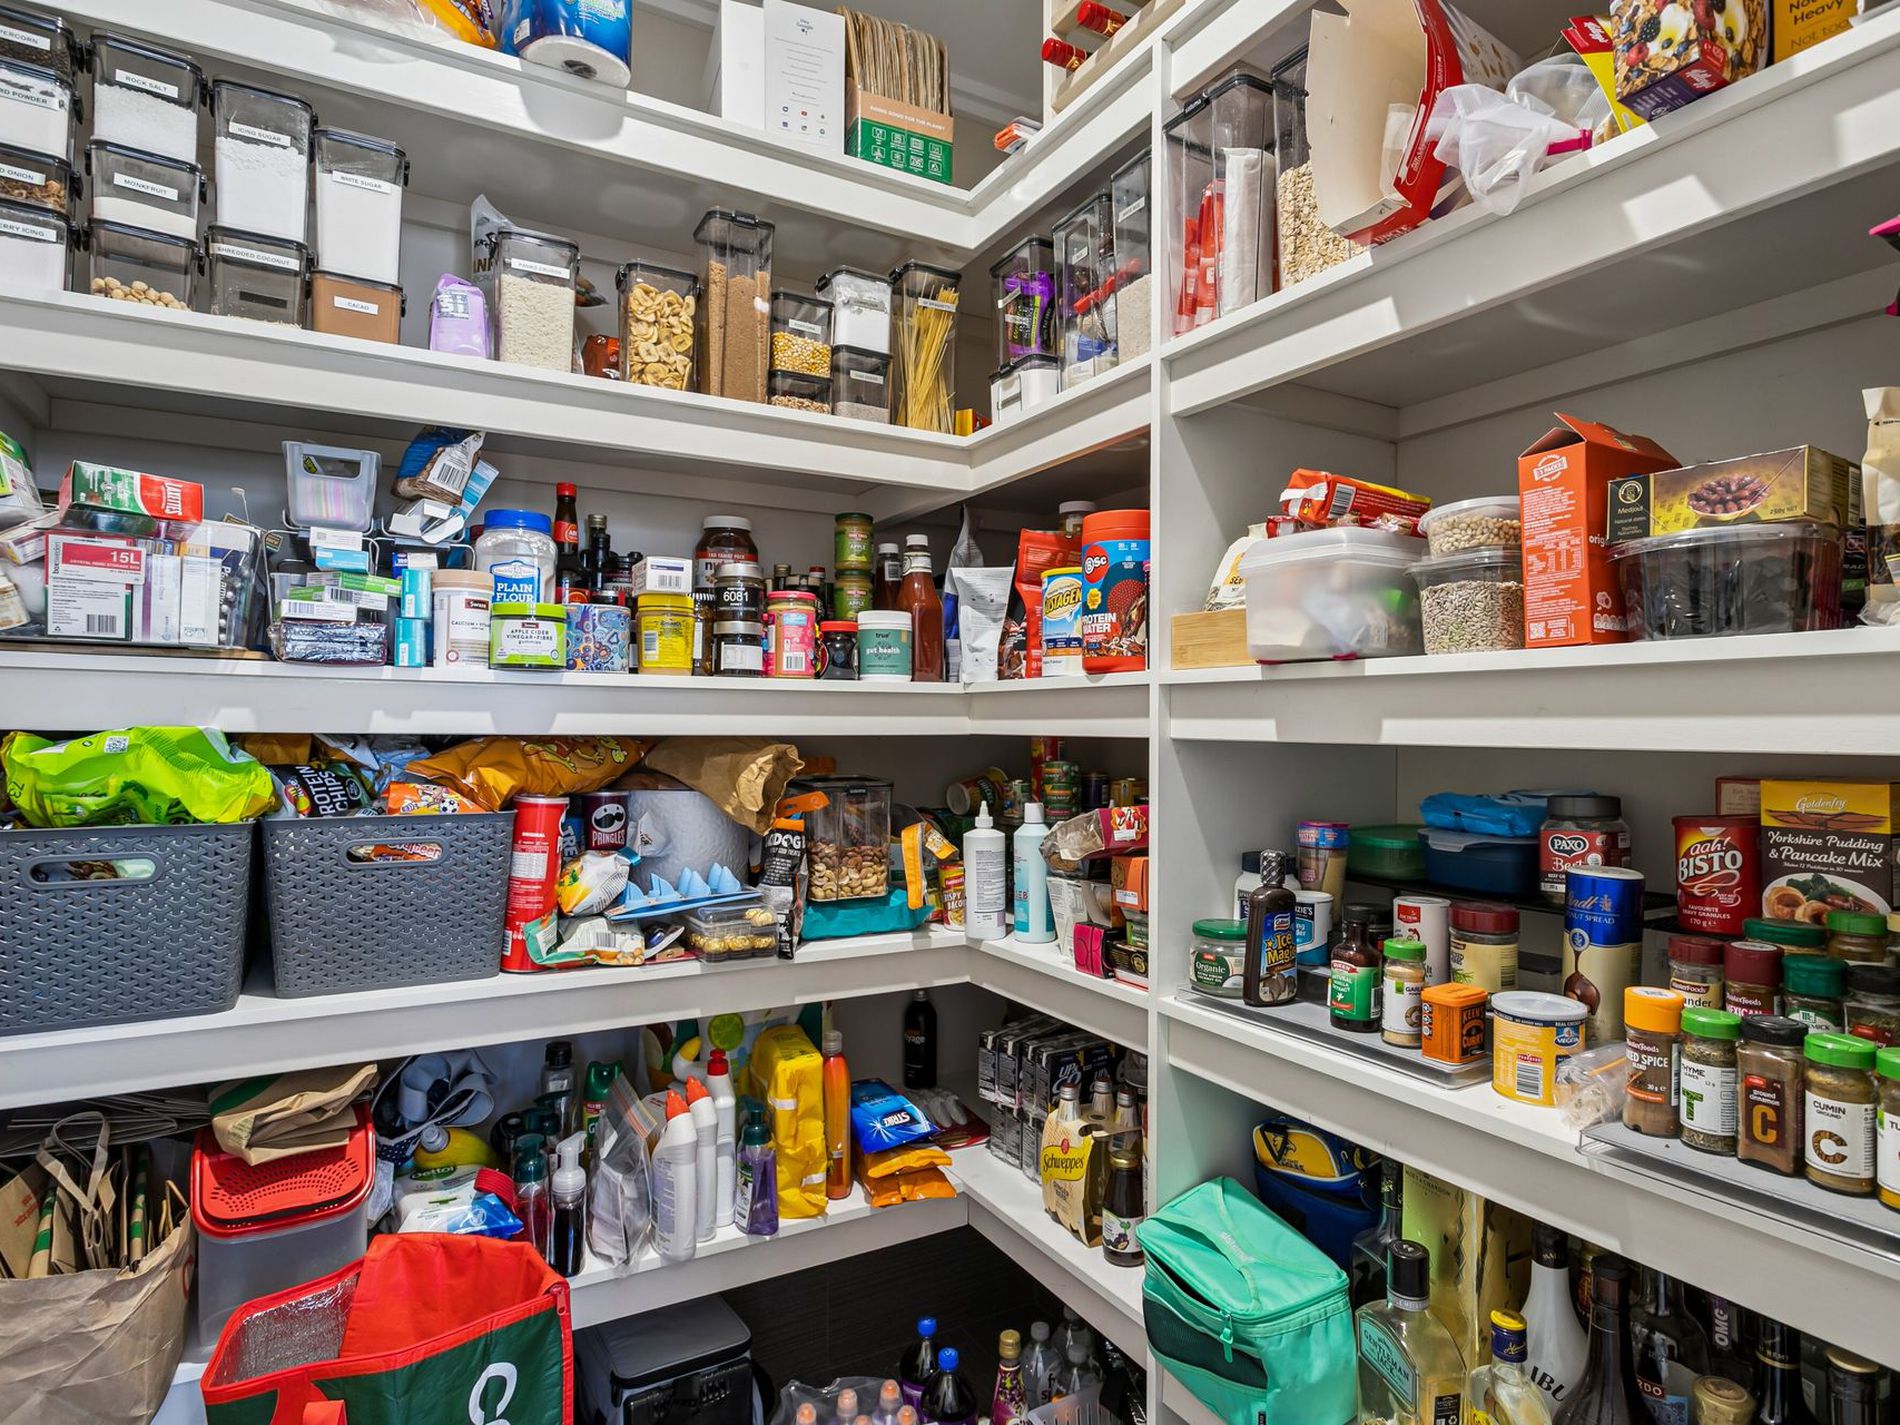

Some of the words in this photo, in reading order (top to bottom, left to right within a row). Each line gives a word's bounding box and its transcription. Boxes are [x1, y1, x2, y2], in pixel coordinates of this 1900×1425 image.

[1793, 0, 1844, 26] Heavy
[0, 29, 38, 44] ERCORN
[125, 74, 147, 87] ROCK
[149, 80, 167, 93] SALT
[12, 91, 48, 105] POWDER
[237, 127, 257, 137] ICING
[258, 132, 281, 143] SUGAR
[7, 169, 34, 181] ONION
[124, 178, 167, 196] MONKFRUIT
[360, 180, 382, 190] SUGAR
[21, 227, 45, 237] ICING
[217, 246, 256, 259] SHREDDED
[256, 254, 290, 266] COCONUT
[110, 551, 141, 564] 15L
[497, 583, 533, 594] PLAIN
[496, 593, 534, 602] FLOUR
[723, 592, 749, 602] 6081
[1083, 613, 1117, 624] PROTEIN
[1083, 623, 1111, 634] WATER
[319, 771, 349, 811] CHIPS
[1796, 797, 1846, 814] Goldenfry
[592, 831, 625, 847] PRINGLES
[1554, 839, 1584, 851] PAXO
[1690, 837, 1731, 856] aah!
[1768, 831, 1822, 846] Yorkshire
[1826, 835, 1884, 854] Pudding
[1552, 857, 1584, 872] Best
[1769, 848, 1778, 859] &
[1780, 846, 1846, 865] Pancake
[1848, 852, 1883, 868] Mix
[1679, 850, 1743, 882] BISTO
[1585, 915, 1614, 924] SPREAD
[1273, 934, 1292, 949] Ice
[1267, 945, 1297, 965] Magic
[1195, 961, 1226, 974] Organic
[1463, 1036, 1483, 1047] CURRY
[1641, 1055, 1668, 1068] SPICE
[1681, 1064, 1705, 1077] THYME
[1813, 1100, 1846, 1115] CUMIN
[1752, 1104, 1777, 1144] C
[1811, 1129, 1848, 1165] C
[1043, 1153, 1084, 1174] Schweppes
[1364, 1329, 1409, 1381] GENTLEMAN
[1377, 1352, 1396, 1376] JACK
